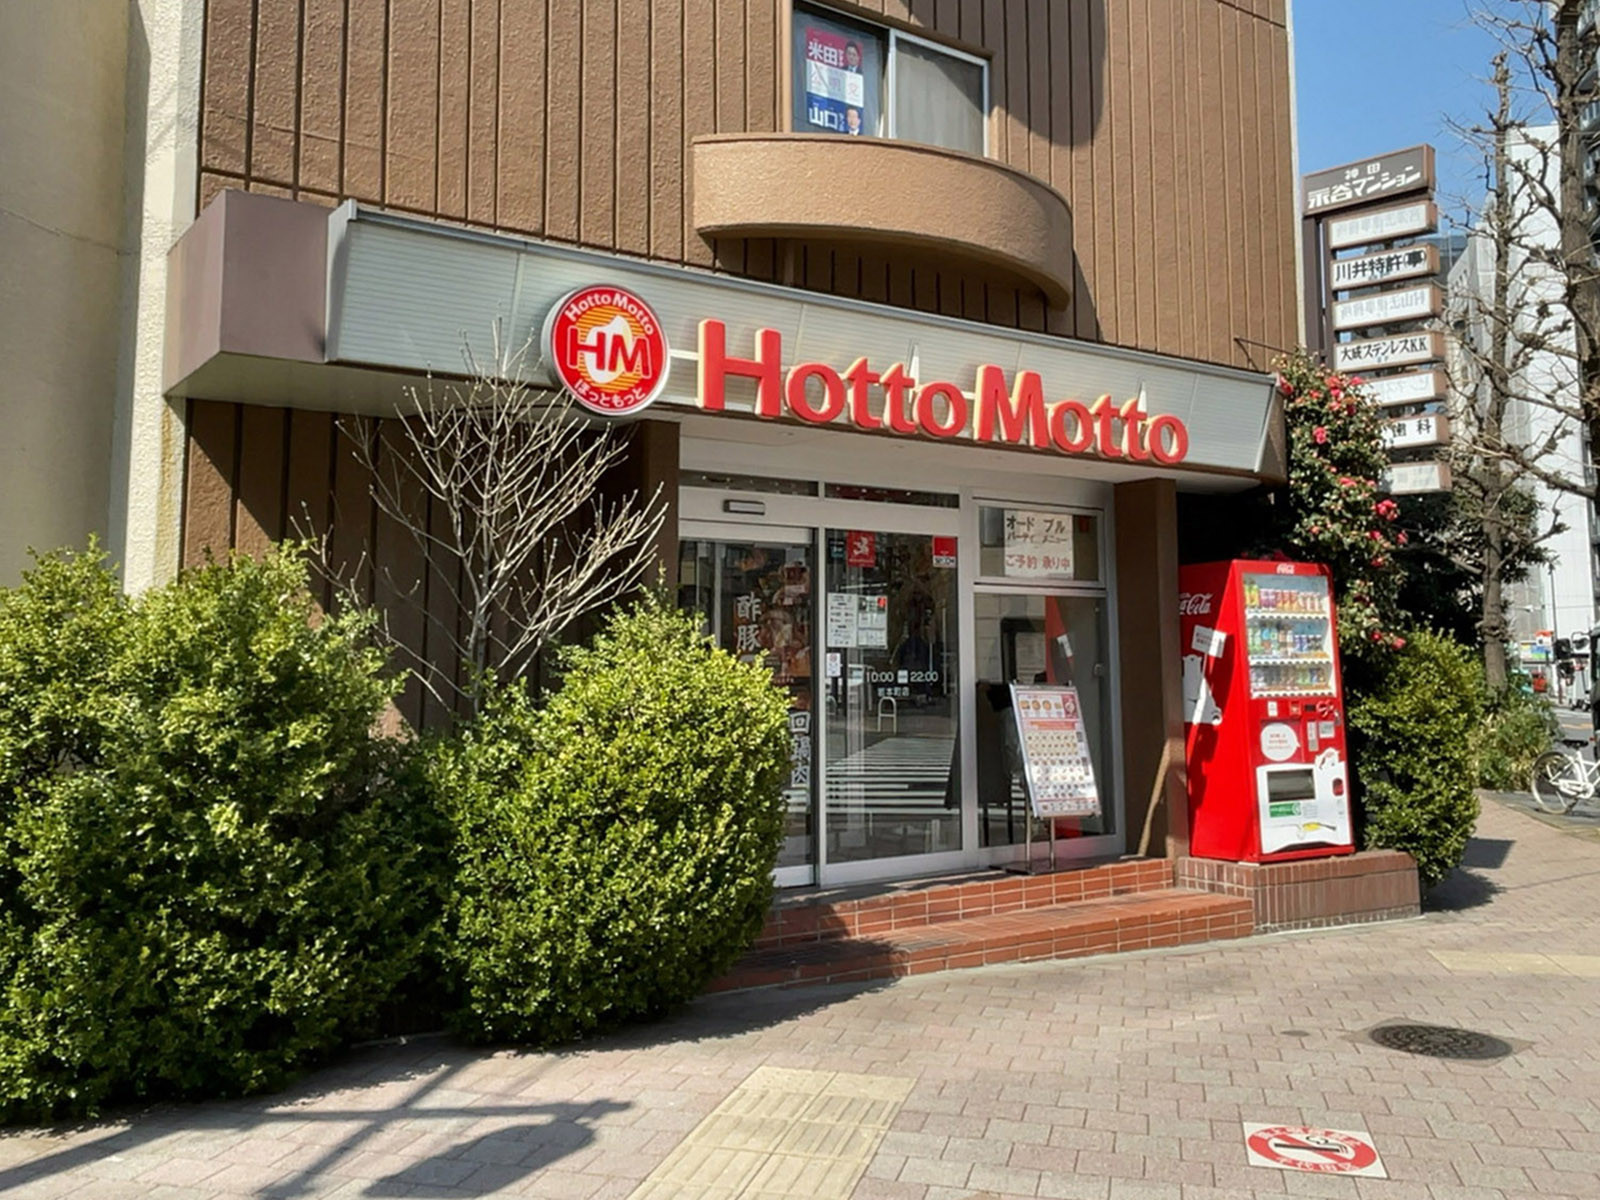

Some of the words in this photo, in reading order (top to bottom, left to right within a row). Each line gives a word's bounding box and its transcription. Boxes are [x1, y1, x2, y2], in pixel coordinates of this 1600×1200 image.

[808, 41, 838, 66] 米田
[809, 105, 838, 130] 山口
[565, 293, 612, 322] Hotto
[612, 292, 655, 336] Motto
[567, 325, 652, 379] HM
[574, 378, 647, 408] ほっともっと
[695, 318, 968, 438] Hotto
[973, 362, 1190, 465] Motto
[737, 592, 763, 651] 酢豚
[866, 671, 895, 683] 10:00
[910, 671, 939, 683] 22:00
